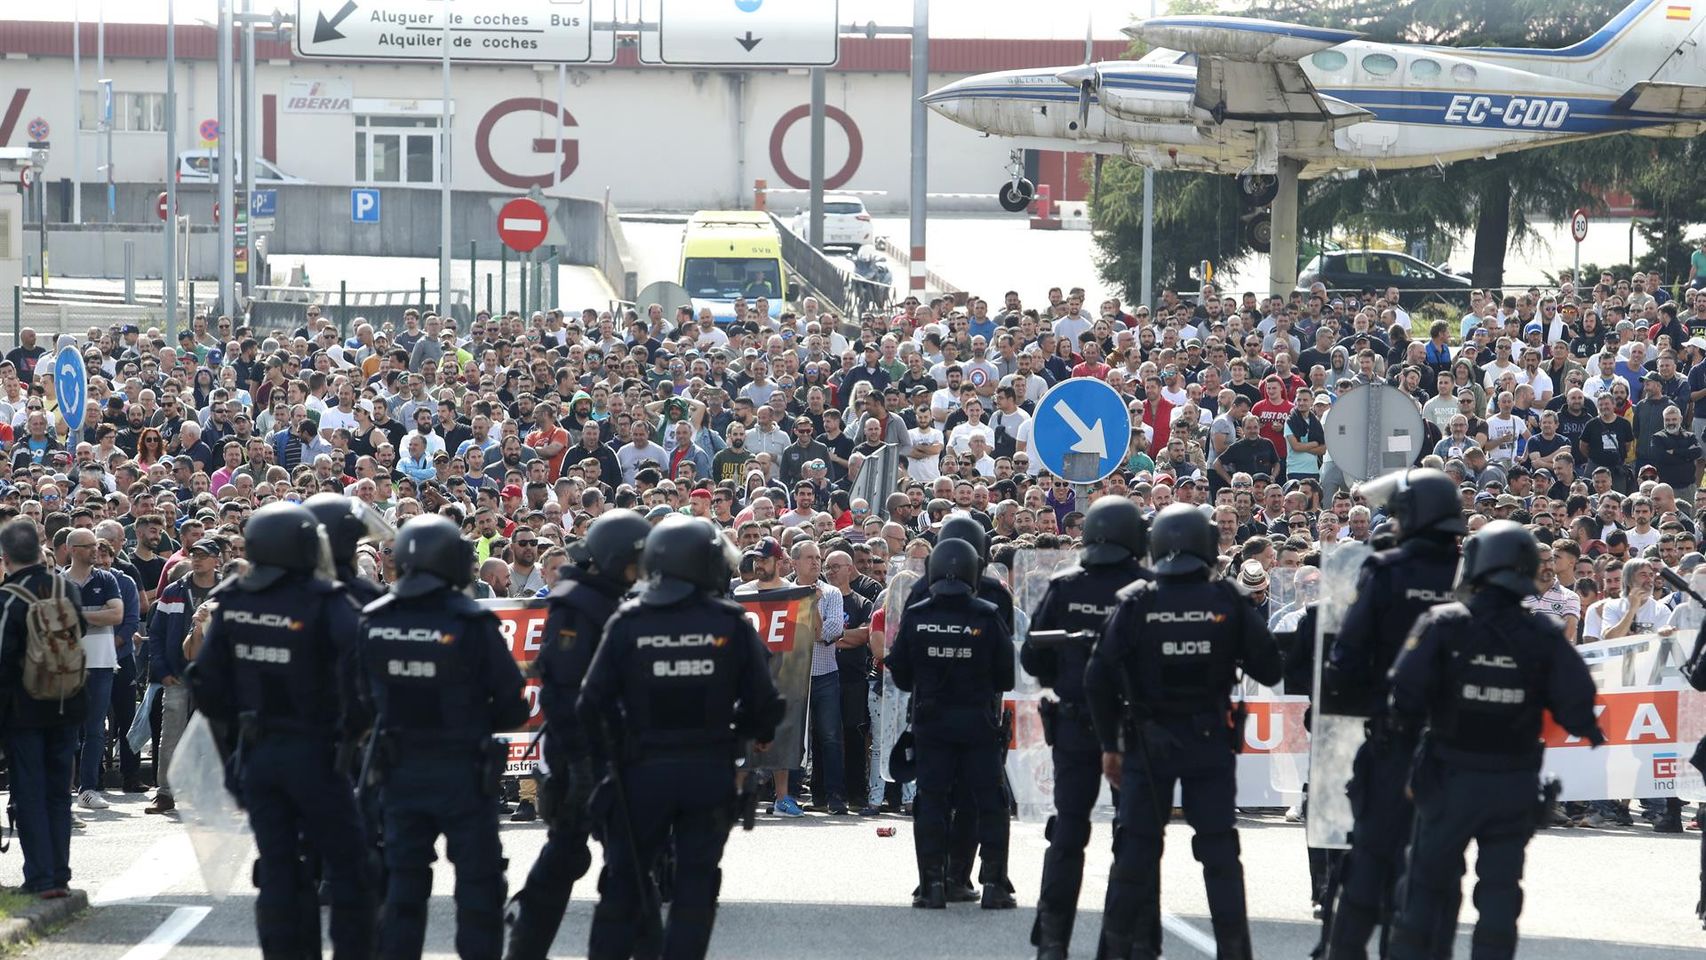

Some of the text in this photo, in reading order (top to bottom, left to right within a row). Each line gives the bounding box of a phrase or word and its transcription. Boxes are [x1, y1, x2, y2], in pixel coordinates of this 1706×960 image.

[370, 10, 434, 25] Aluguer
[474, 14, 529, 25] coches
[551, 14, 580, 26] Bus
[378, 34, 538, 49] Alquiler de coches
[288, 97, 350, 110] IBERIA
[1445, 95, 1570, 128] EC-CDD
[356, 193, 374, 218] P
[1576, 220, 1586, 231] 30
[1261, 411, 1277, 419] JUST
[722, 462, 739, 473] OUT
[223, 610, 290, 628] POLICIA
[1146, 611, 1216, 623] POLICIA
[368, 627, 442, 641] POLICIA
[917, 623, 972, 634] POLICA
[637, 634, 715, 648] POLICIA
